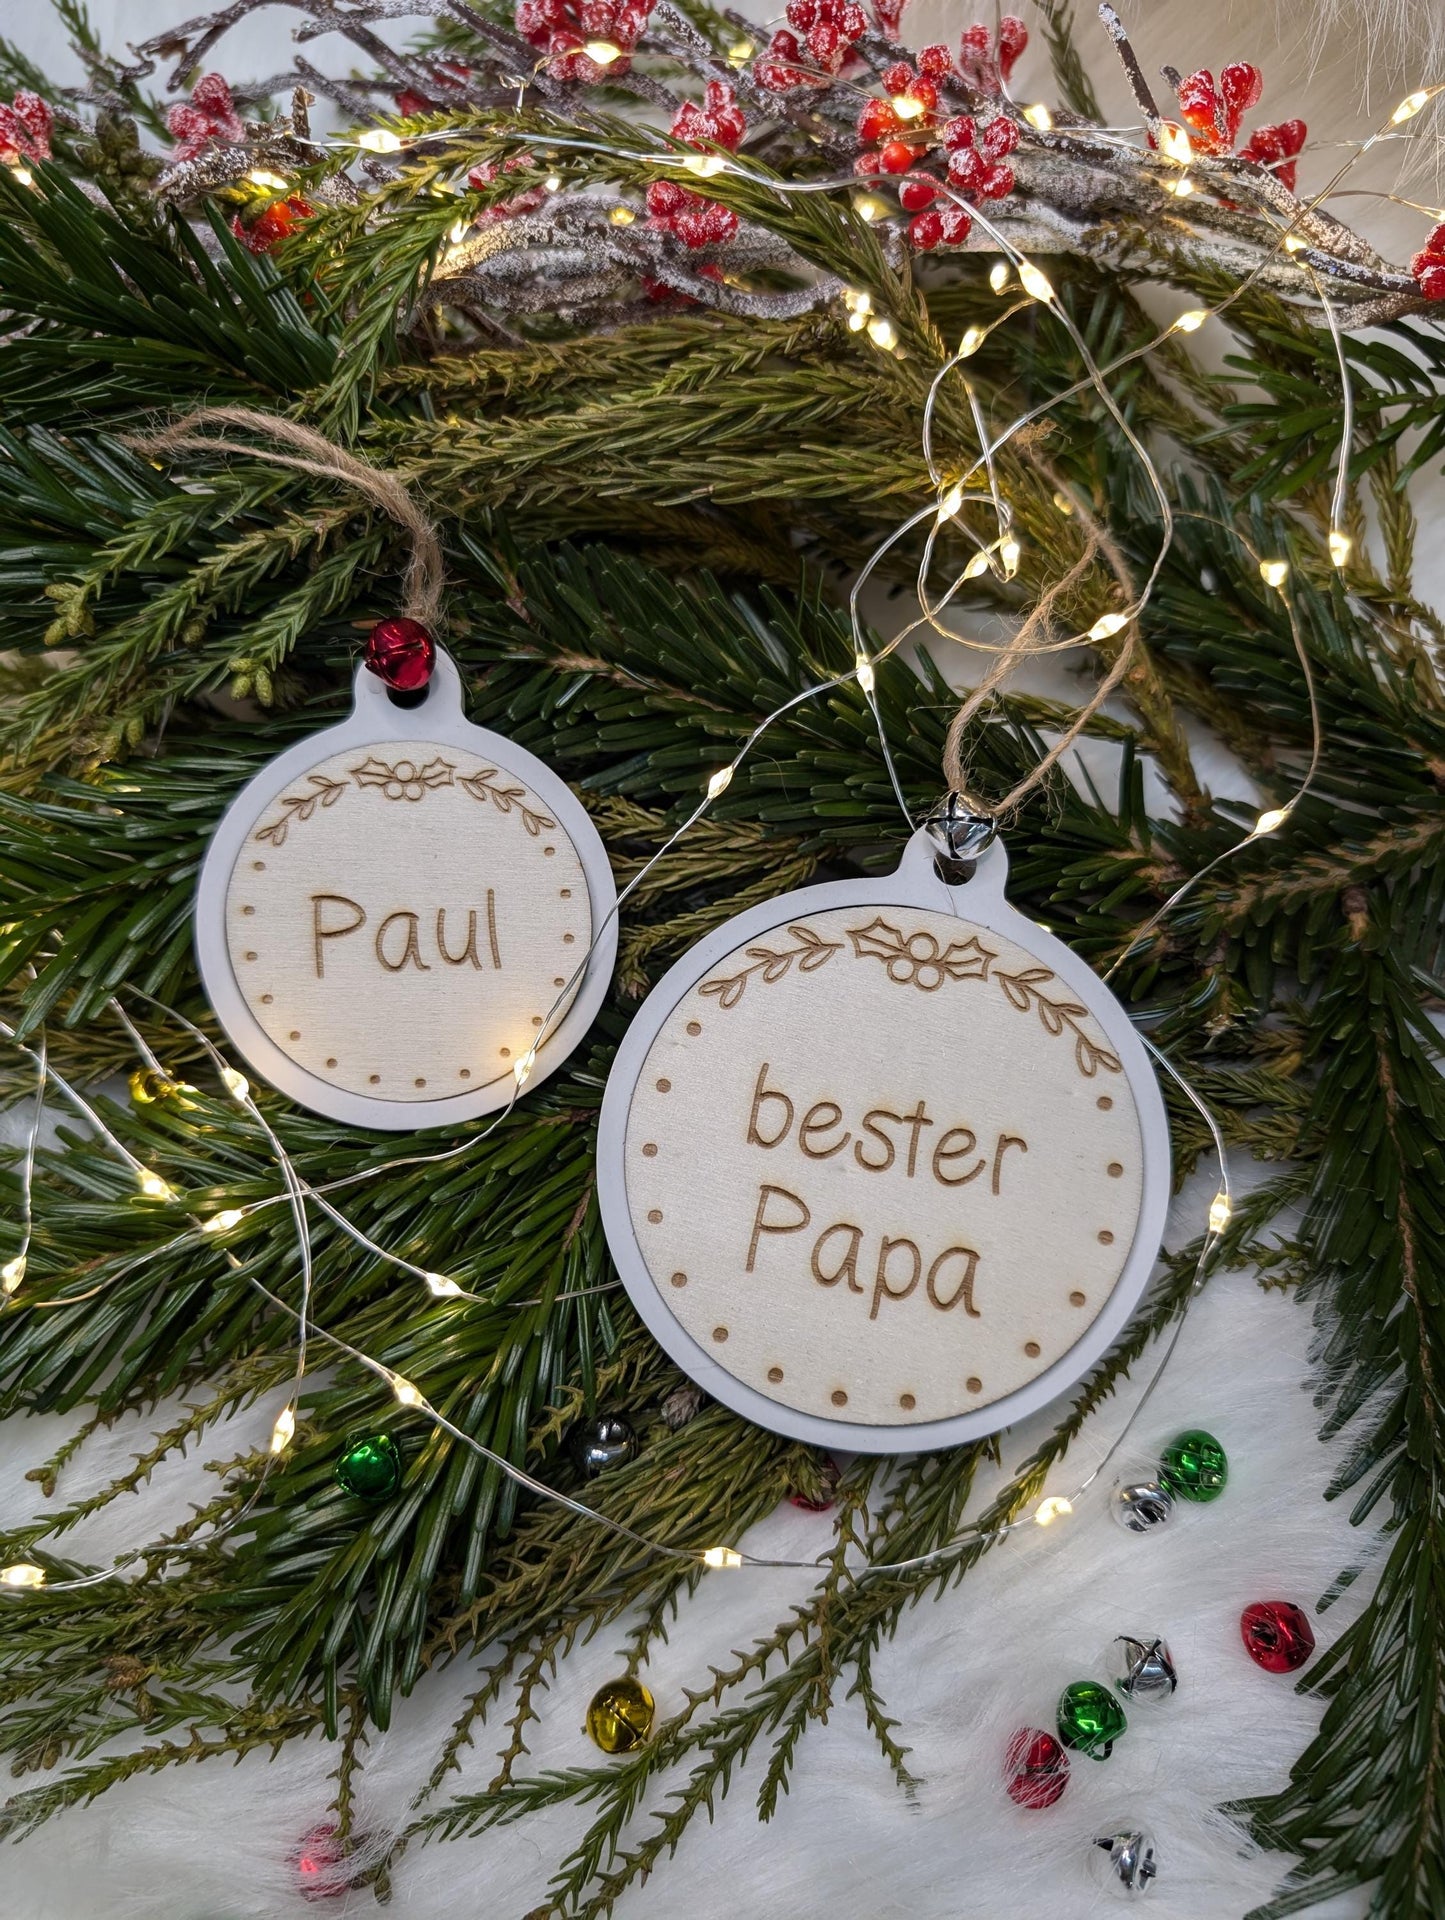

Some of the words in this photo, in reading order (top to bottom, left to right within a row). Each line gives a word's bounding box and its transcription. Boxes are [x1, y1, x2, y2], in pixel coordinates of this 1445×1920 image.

[311, 888, 502, 979] Paul
[746, 1062, 1029, 1196] bester
[745, 1184, 981, 1321] Papa
